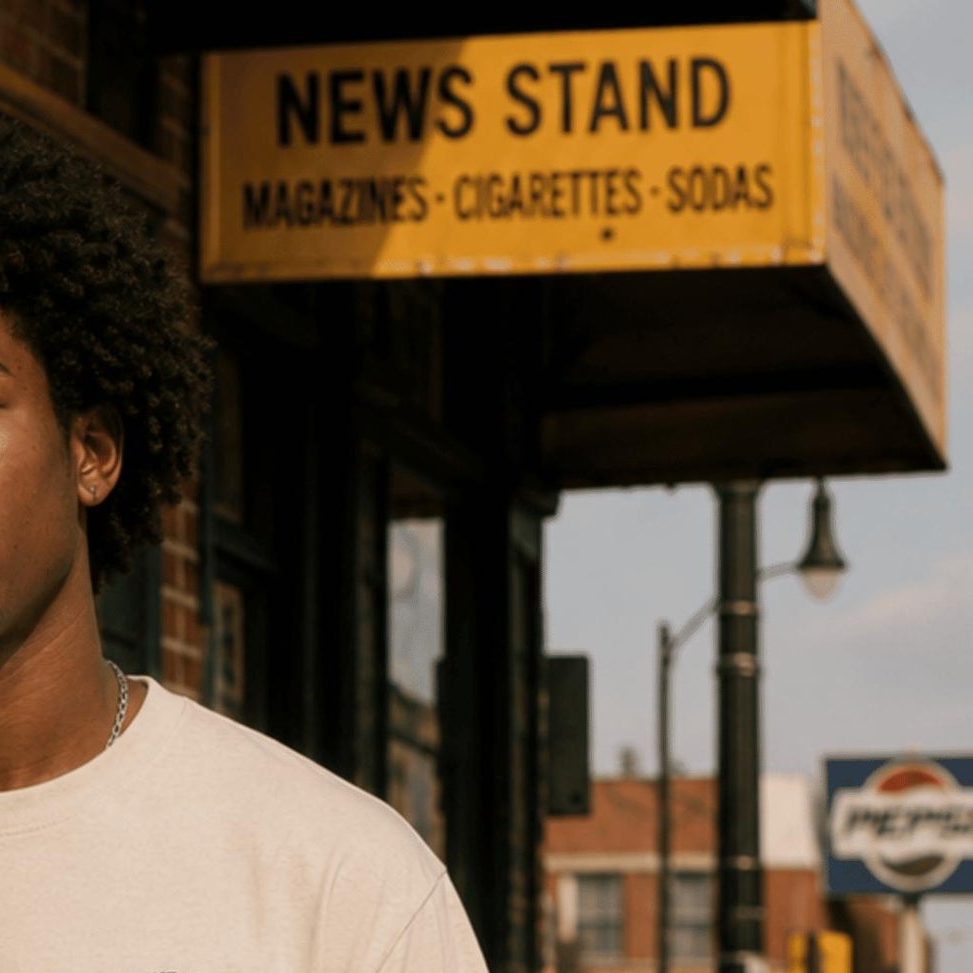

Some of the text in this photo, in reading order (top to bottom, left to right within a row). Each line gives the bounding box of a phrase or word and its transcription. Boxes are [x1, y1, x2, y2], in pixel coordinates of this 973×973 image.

[276, 56, 730, 147] NEWS STAND
[242, 163, 774, 230] MAGAZINES CIGARETTES SODAS
[843, 805, 973, 841] PEPS
